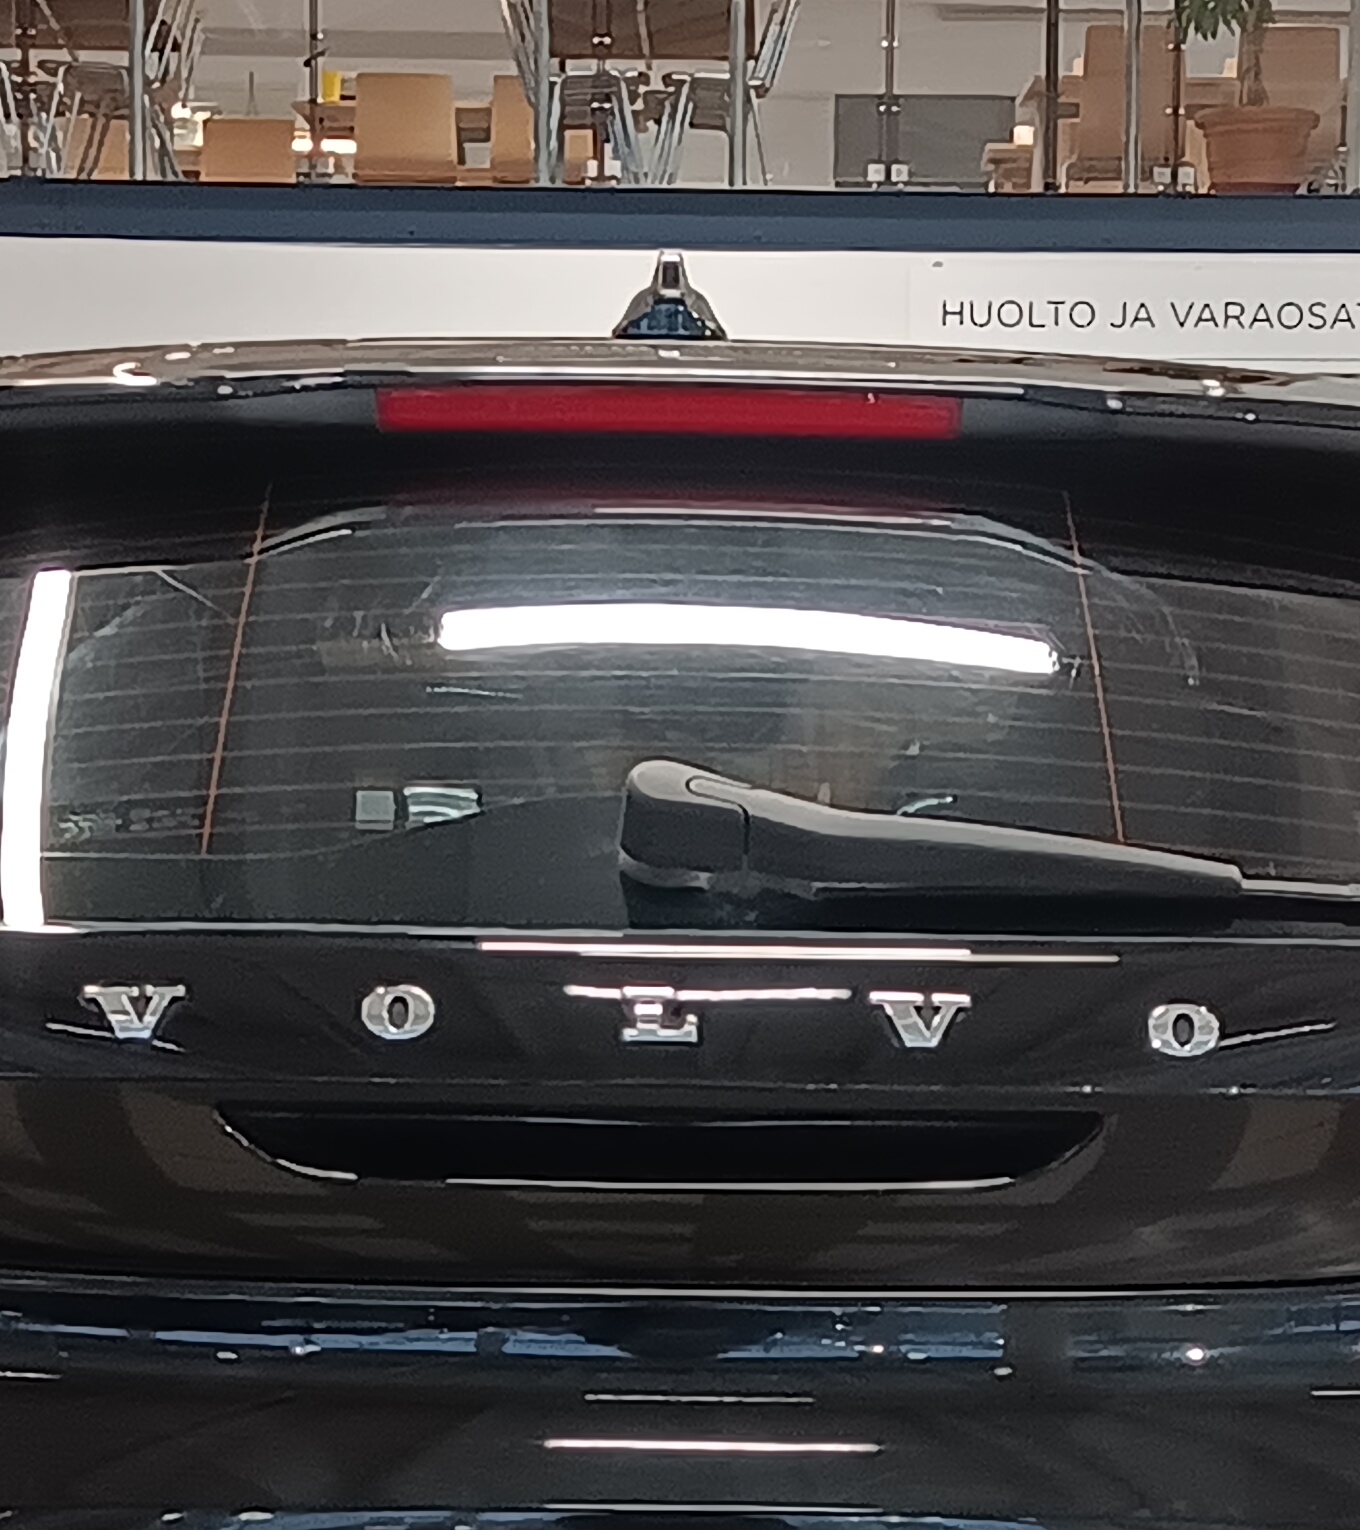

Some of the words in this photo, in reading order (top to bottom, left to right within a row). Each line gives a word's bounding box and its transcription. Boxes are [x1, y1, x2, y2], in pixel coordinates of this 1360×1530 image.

[941, 299, 1097, 329] HUOLTO
[1110, 300, 1156, 329] JA
[78, 982, 1223, 1058] VOLVO
